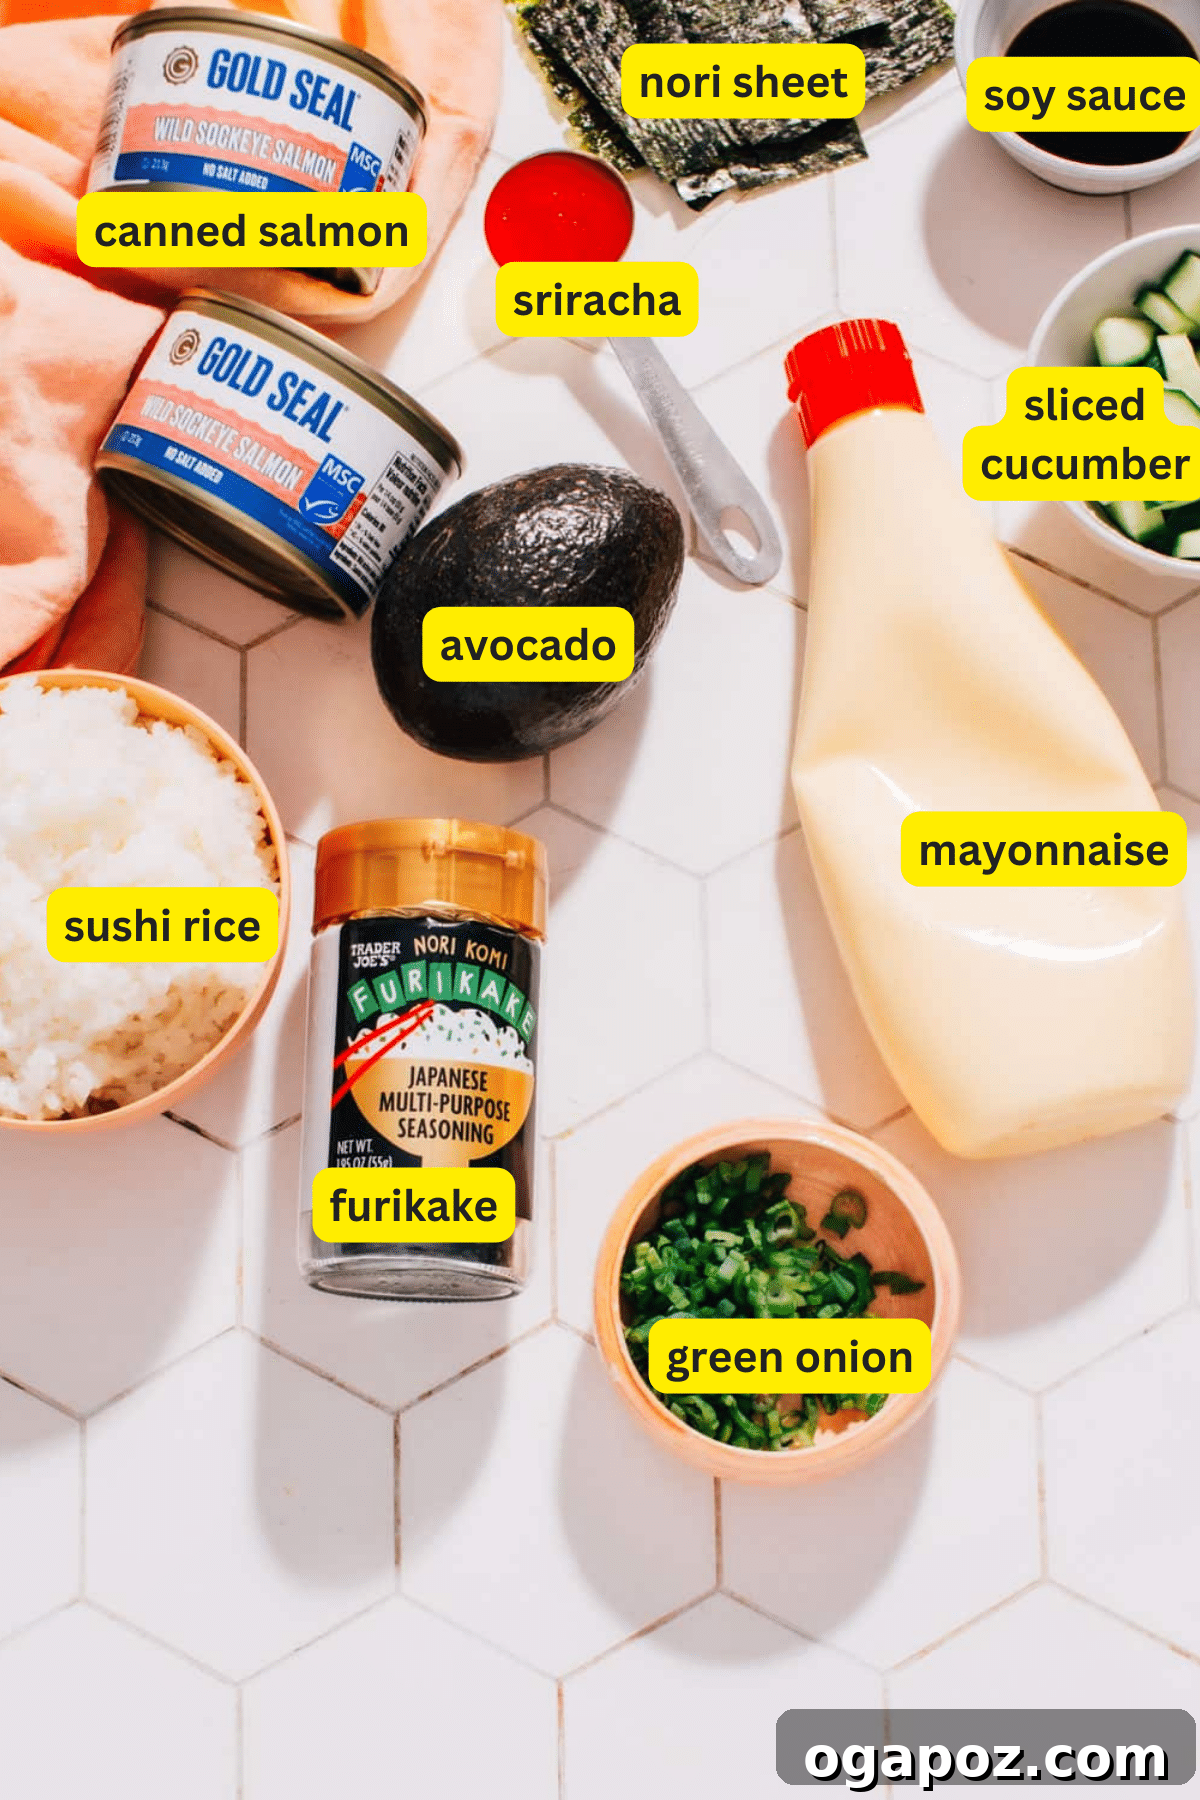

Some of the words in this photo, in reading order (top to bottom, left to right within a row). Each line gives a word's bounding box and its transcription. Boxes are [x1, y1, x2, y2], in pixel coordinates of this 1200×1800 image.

[206, 48, 288, 101] GOLD
[289, 68, 358, 132] SEAL
[154, 115, 194, 142] WILD
[195, 120, 272, 159] SOCKEYE
[272, 138, 338, 184] SALMON
[350, 145, 380, 177] MSC
[196, 336, 275, 398] GOLD
[268, 370, 345, 444] SEAL
[140, 394, 175, 423] WILD
[169, 404, 240, 453] SOCKEYE
[232, 435, 304, 492] SALMON
[322, 460, 361, 495] MSC
[351, 941, 400, 957] TRADER
[413, 935, 456, 956] NORI
[465, 939, 508, 969] KOMI
[353, 968, 536, 1035] FURIKAKE
[408, 1065, 488, 1092] JAPANESE
[379, 1091, 511, 1123] MULTI-PURPOSE
[336, 1139, 354, 1155] NET
[397, 1117, 494, 1146] SEASONING
